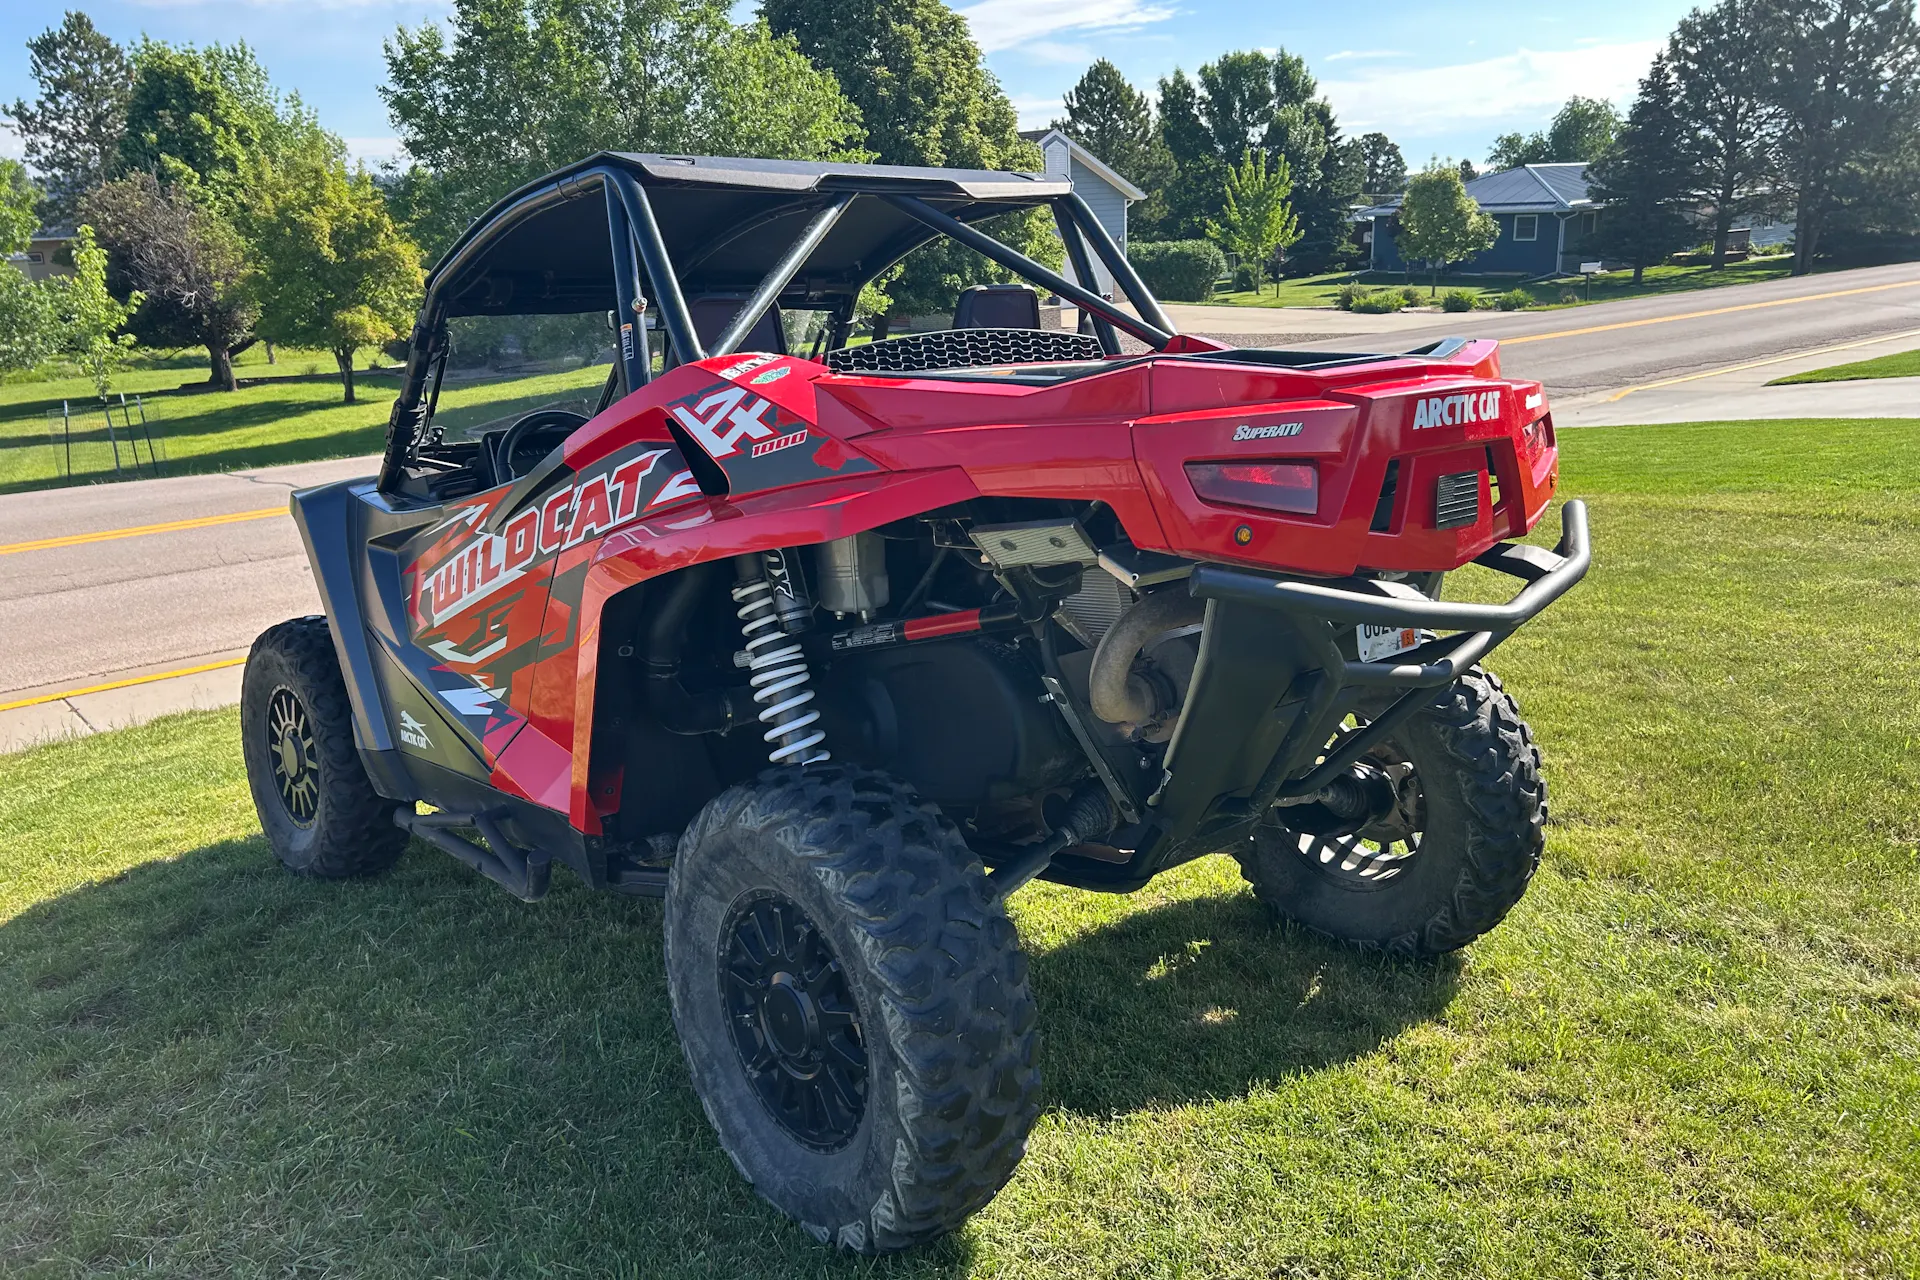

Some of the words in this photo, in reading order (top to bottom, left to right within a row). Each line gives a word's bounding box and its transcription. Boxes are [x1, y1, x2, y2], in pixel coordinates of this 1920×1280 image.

[1412, 393, 1477, 430] ARCTIC
[1478, 390, 1501, 421] CAT
[752, 429, 808, 459] 1000
[429, 448, 672, 620] WILDCAT
